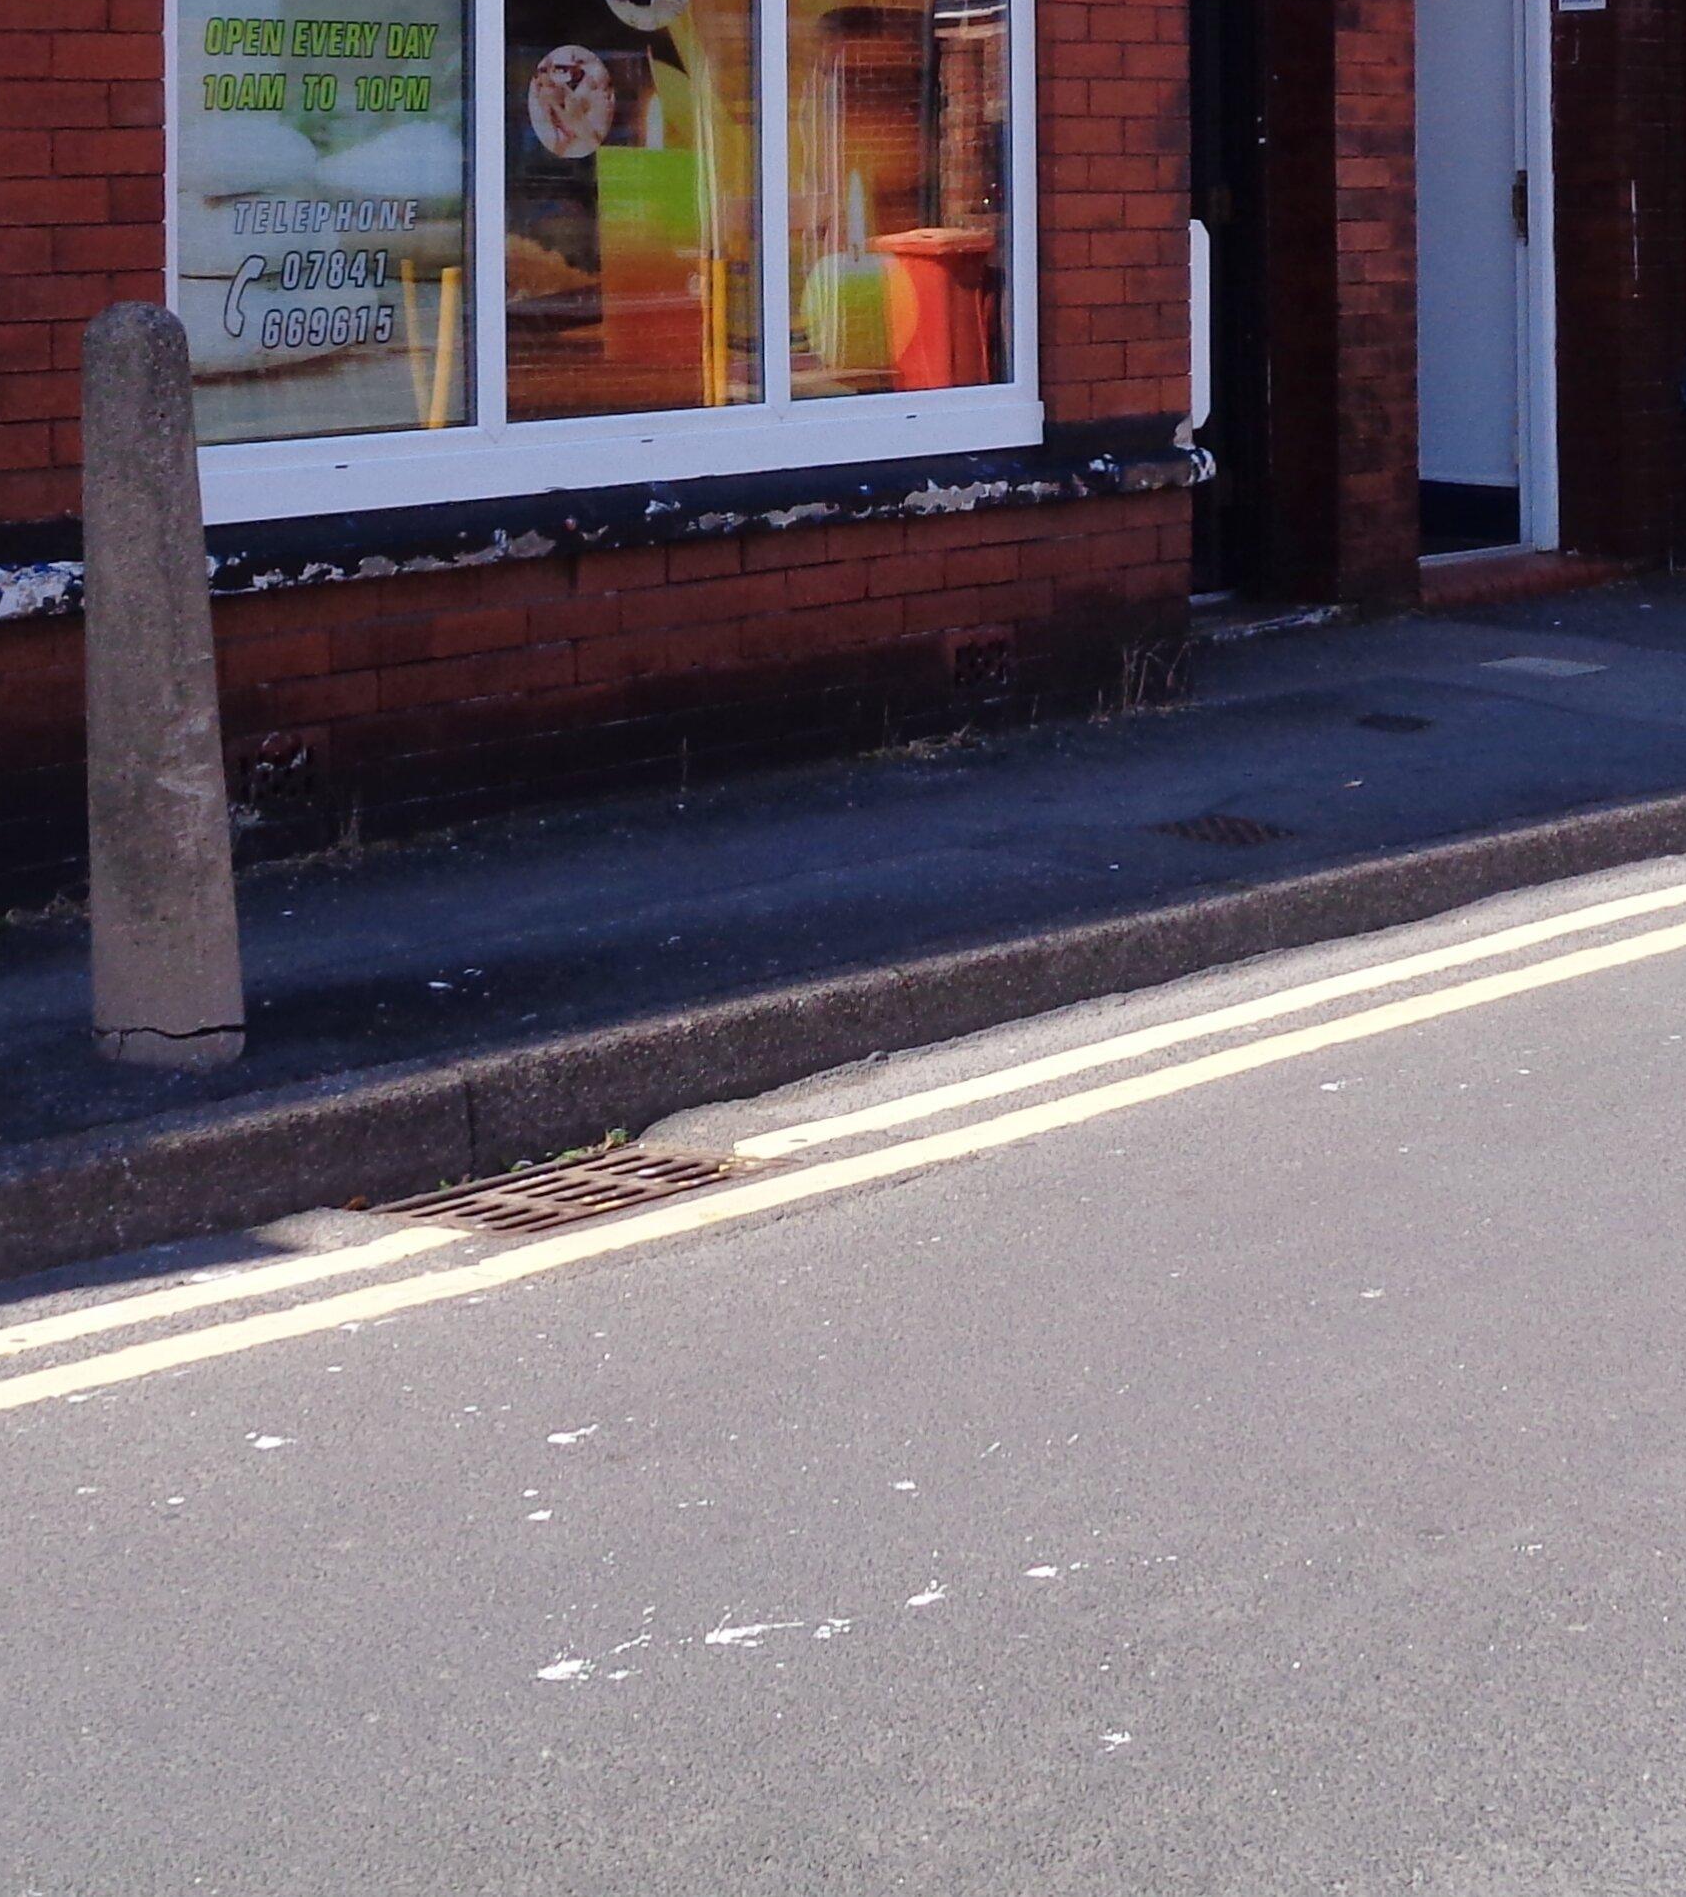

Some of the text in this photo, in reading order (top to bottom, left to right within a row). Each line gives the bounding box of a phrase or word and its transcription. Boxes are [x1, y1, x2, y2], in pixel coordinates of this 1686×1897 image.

[204, 17, 440, 60] OPEN EVERY DAY
[203, 73, 432, 113] 10AM TO 10PM
[234, 199, 419, 235] TELEPHONE
[281, 249, 390, 291] 07841
[261, 305, 395, 350] 669615
